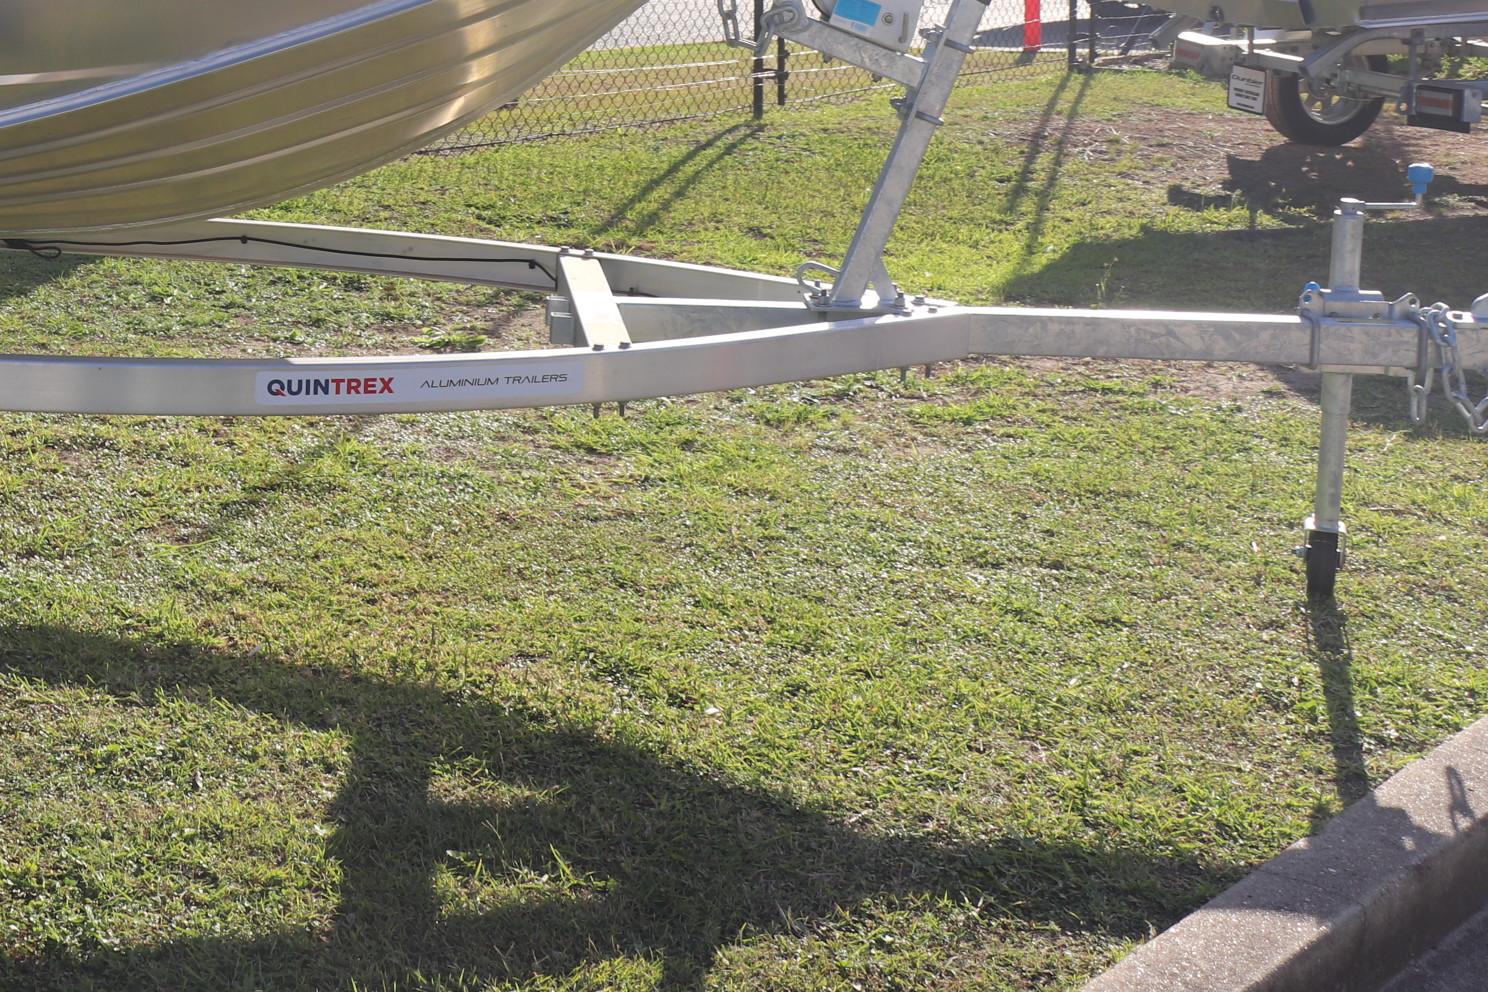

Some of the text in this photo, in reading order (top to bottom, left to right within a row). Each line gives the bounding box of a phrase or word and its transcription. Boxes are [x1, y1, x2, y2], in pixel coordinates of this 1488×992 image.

[267, 373, 568, 397] QUINTREX ALUMINIUM TRAILERS
